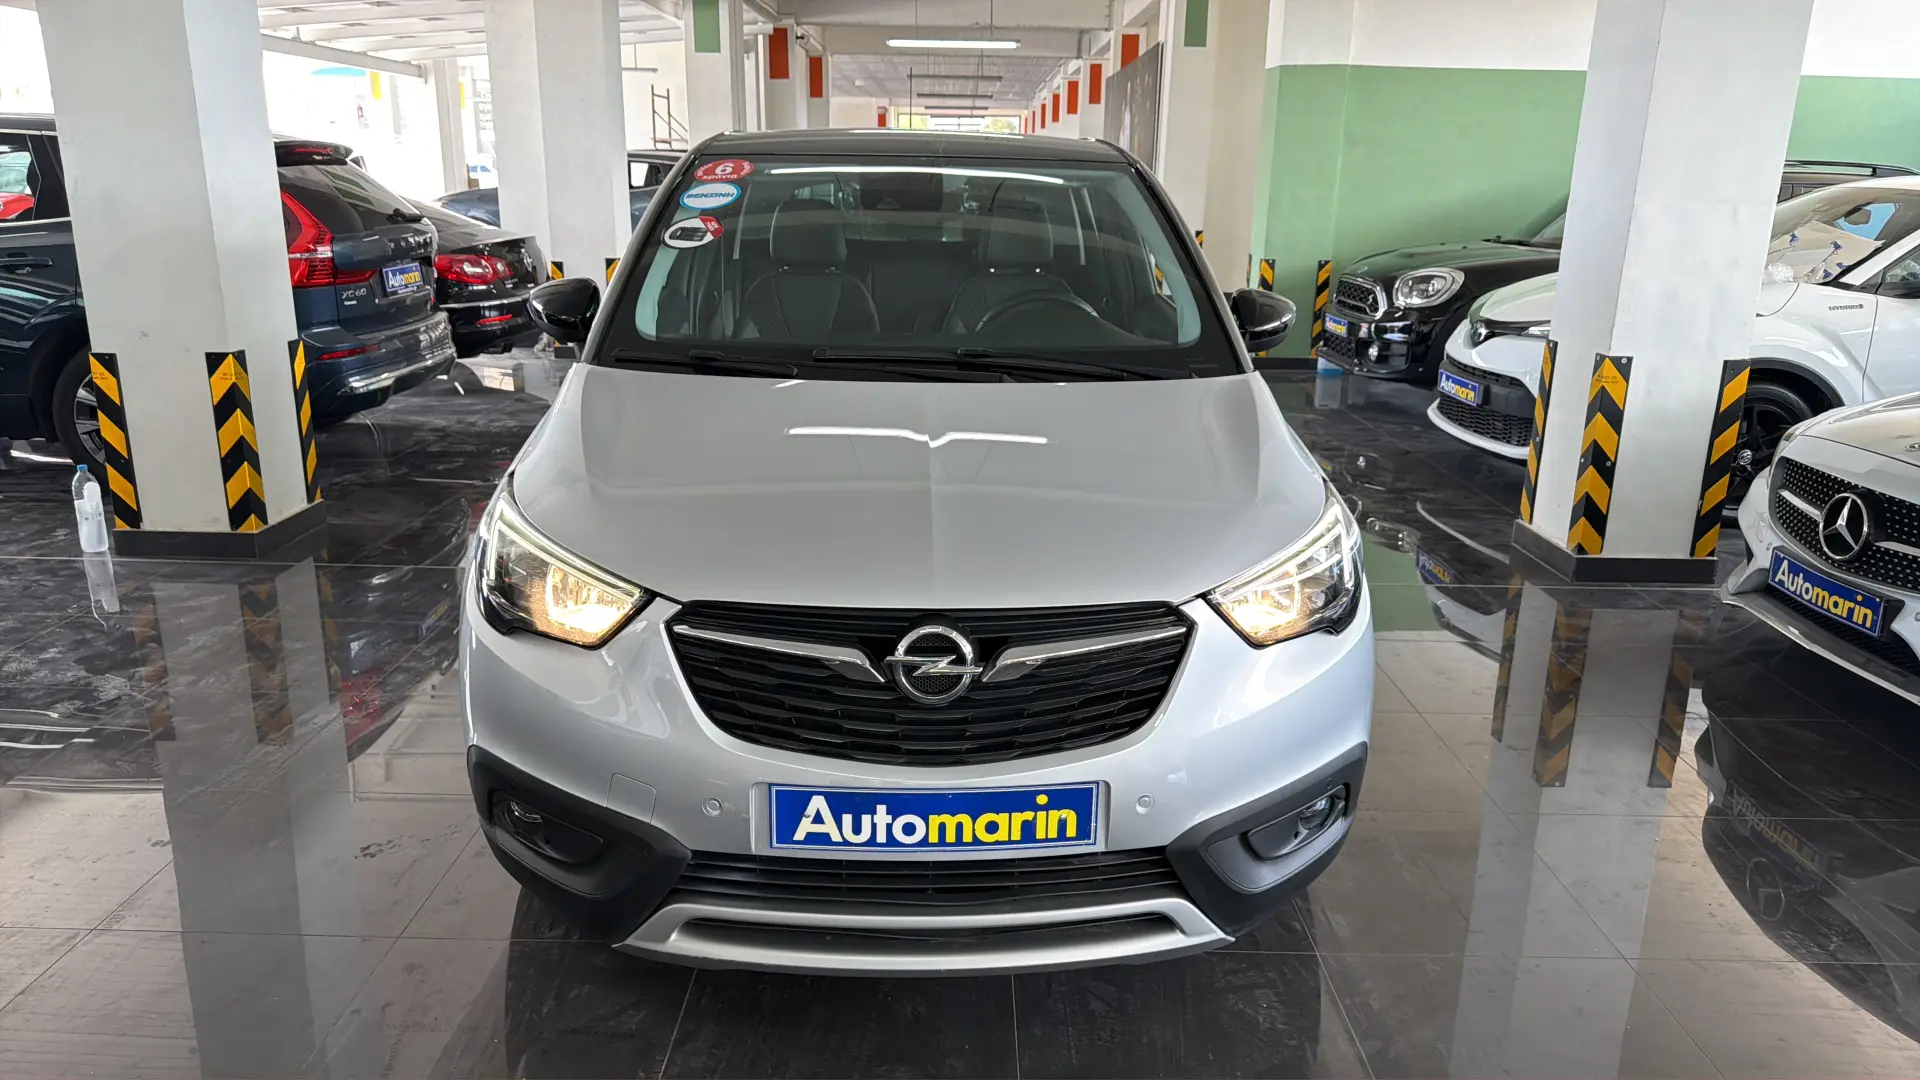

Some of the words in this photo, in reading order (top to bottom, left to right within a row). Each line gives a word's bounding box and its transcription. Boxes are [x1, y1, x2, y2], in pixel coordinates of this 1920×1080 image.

[714, 162, 735, 175] 6
[388, 266, 421, 287] Automarin
[1440, 373, 1475, 402] Automarin
[1775, 559, 1873, 628] Automarin
[792, 793, 1078, 844] Automarin
